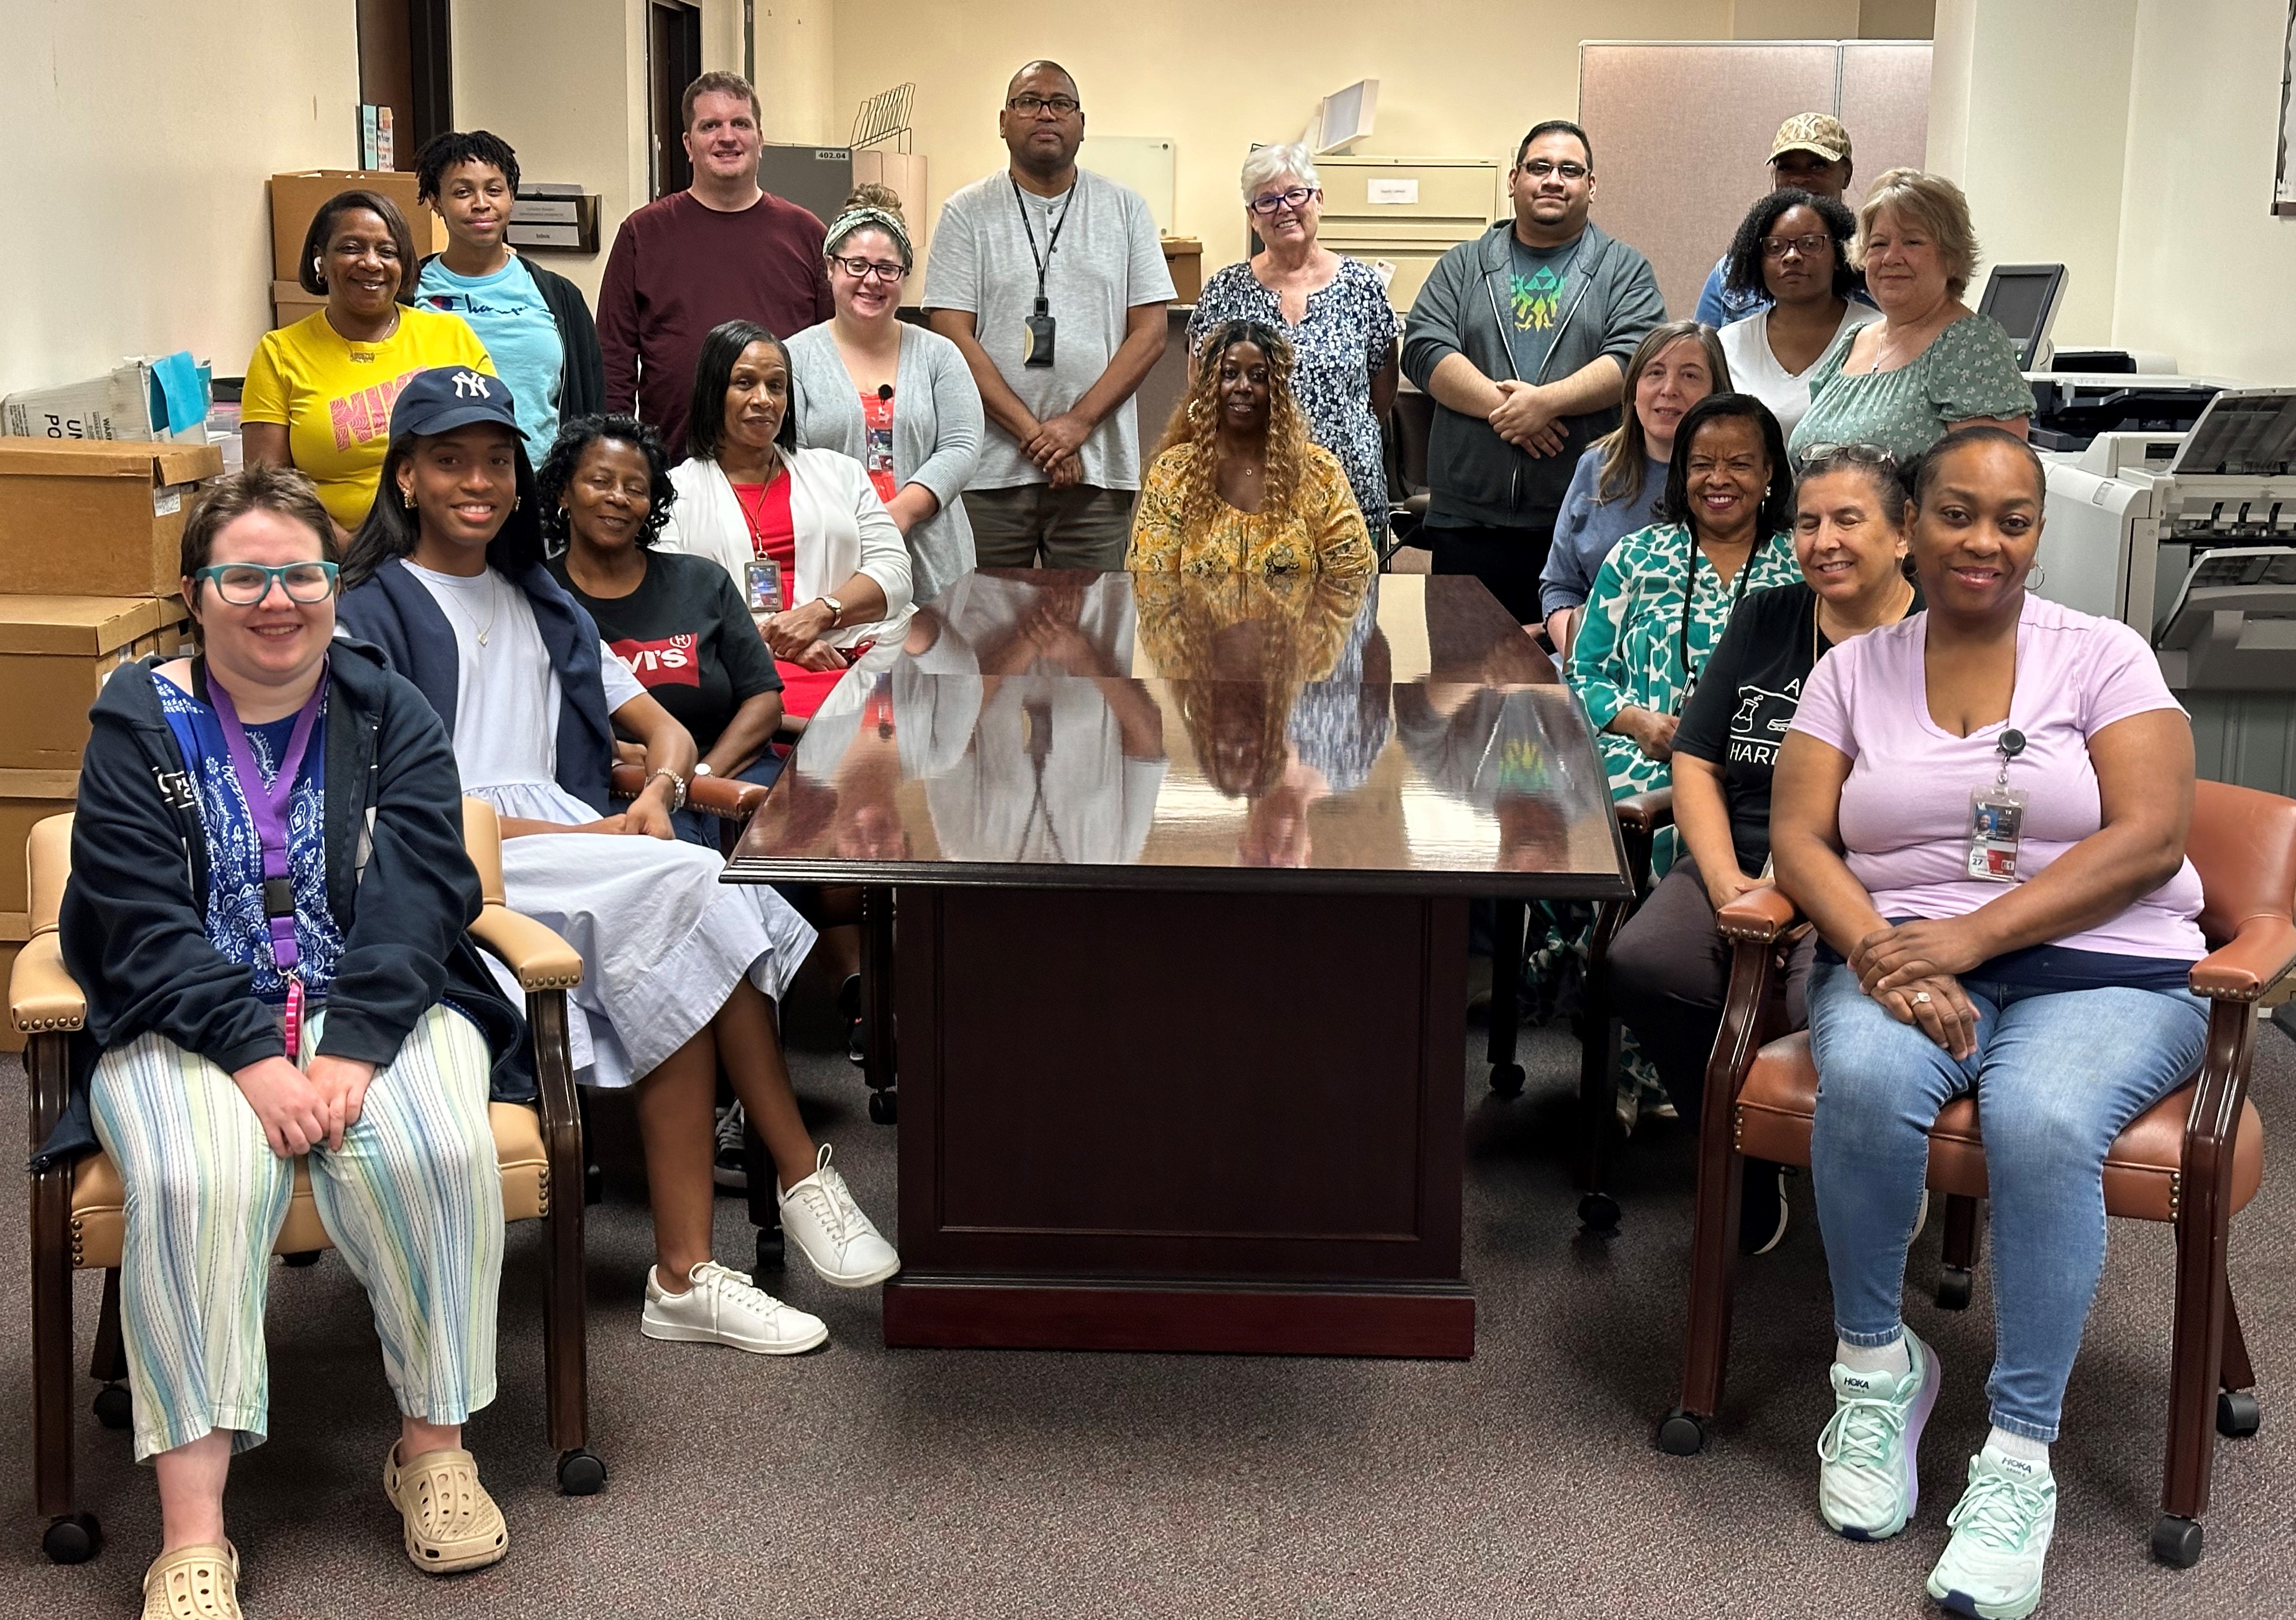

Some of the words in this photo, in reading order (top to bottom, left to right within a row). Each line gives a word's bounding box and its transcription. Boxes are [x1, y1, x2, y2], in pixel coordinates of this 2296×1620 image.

[1789, 112, 1820, 140] NY
[451, 371, 490, 399] NY
[329, 365, 428, 453] NIK
[1844, 1377, 1869, 1389] HOKA
[2002, 1457, 2031, 1474] HOKA
